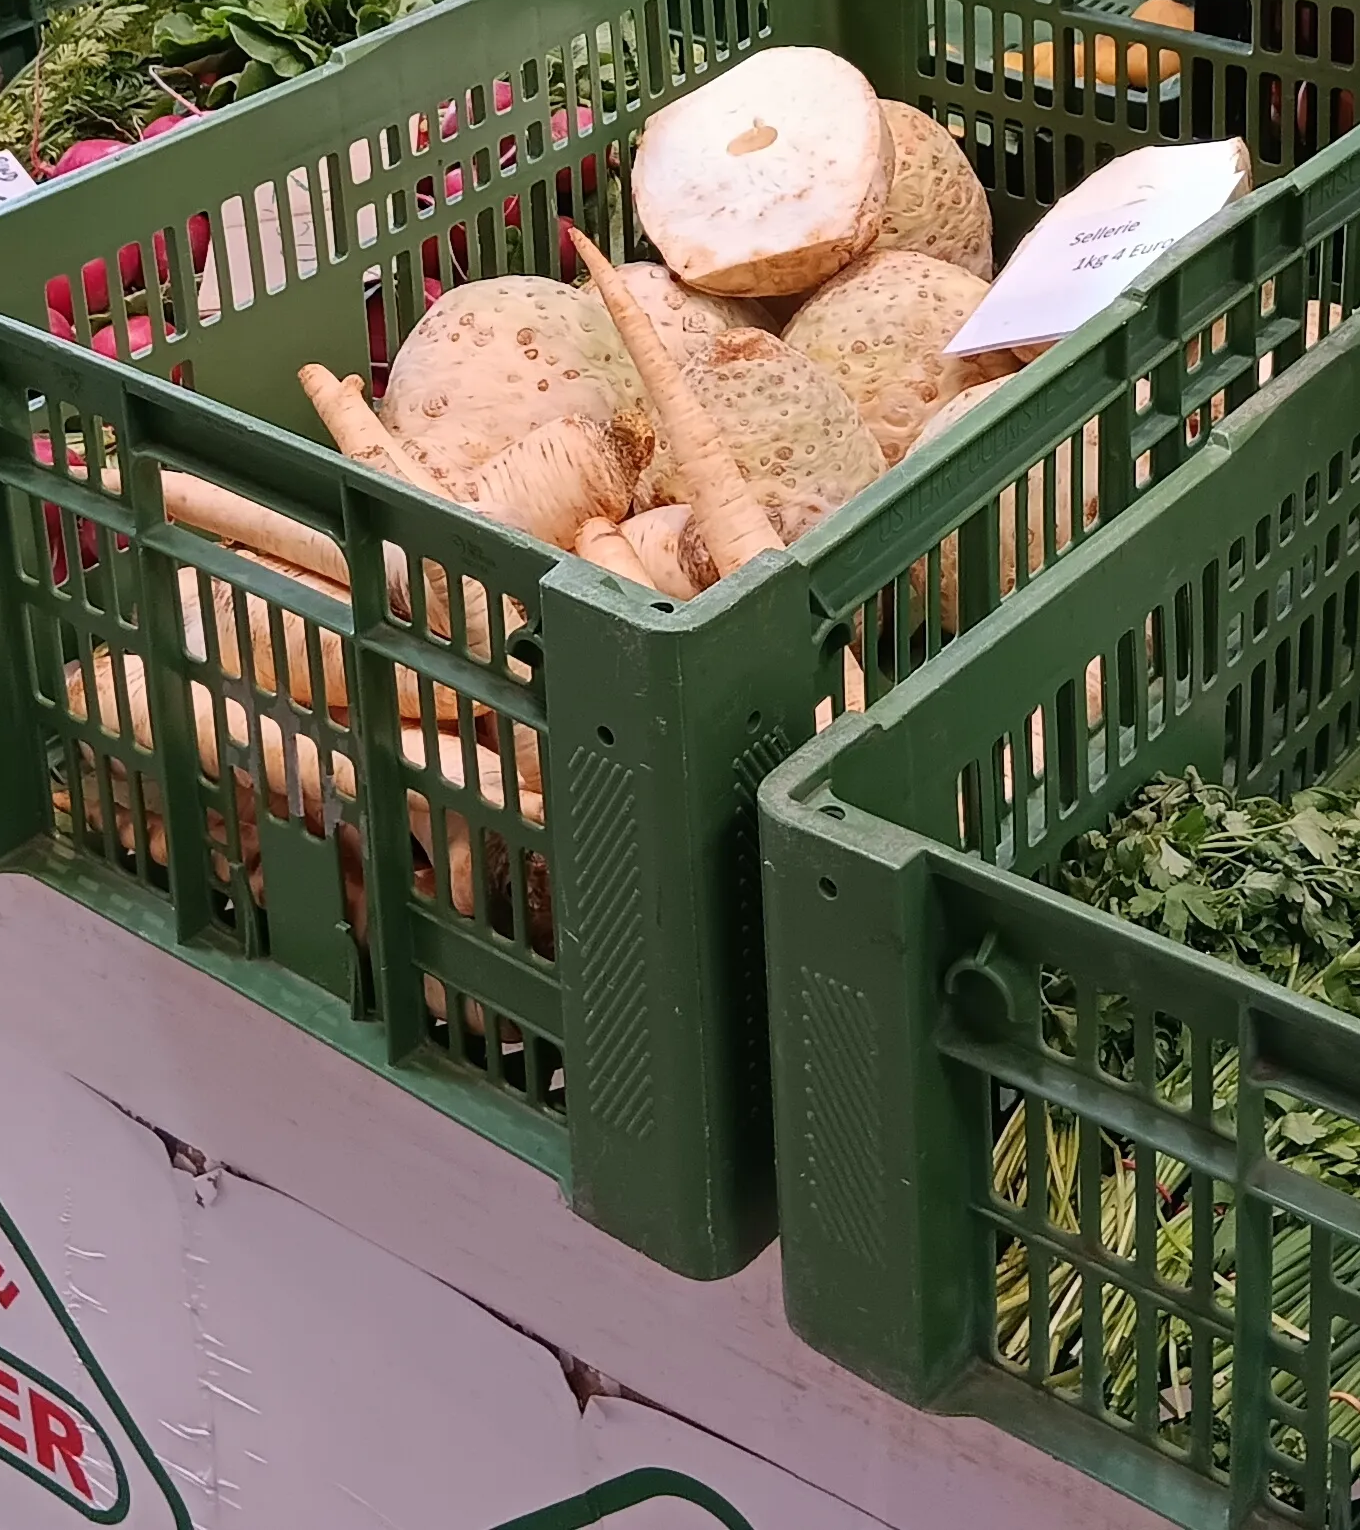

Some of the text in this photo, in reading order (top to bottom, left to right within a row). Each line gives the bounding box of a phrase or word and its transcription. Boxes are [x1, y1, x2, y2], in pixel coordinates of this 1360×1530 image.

[1069, 220, 1141, 246] Sellerie
[1072, 236, 1175, 272] 1kg 4 Euro
